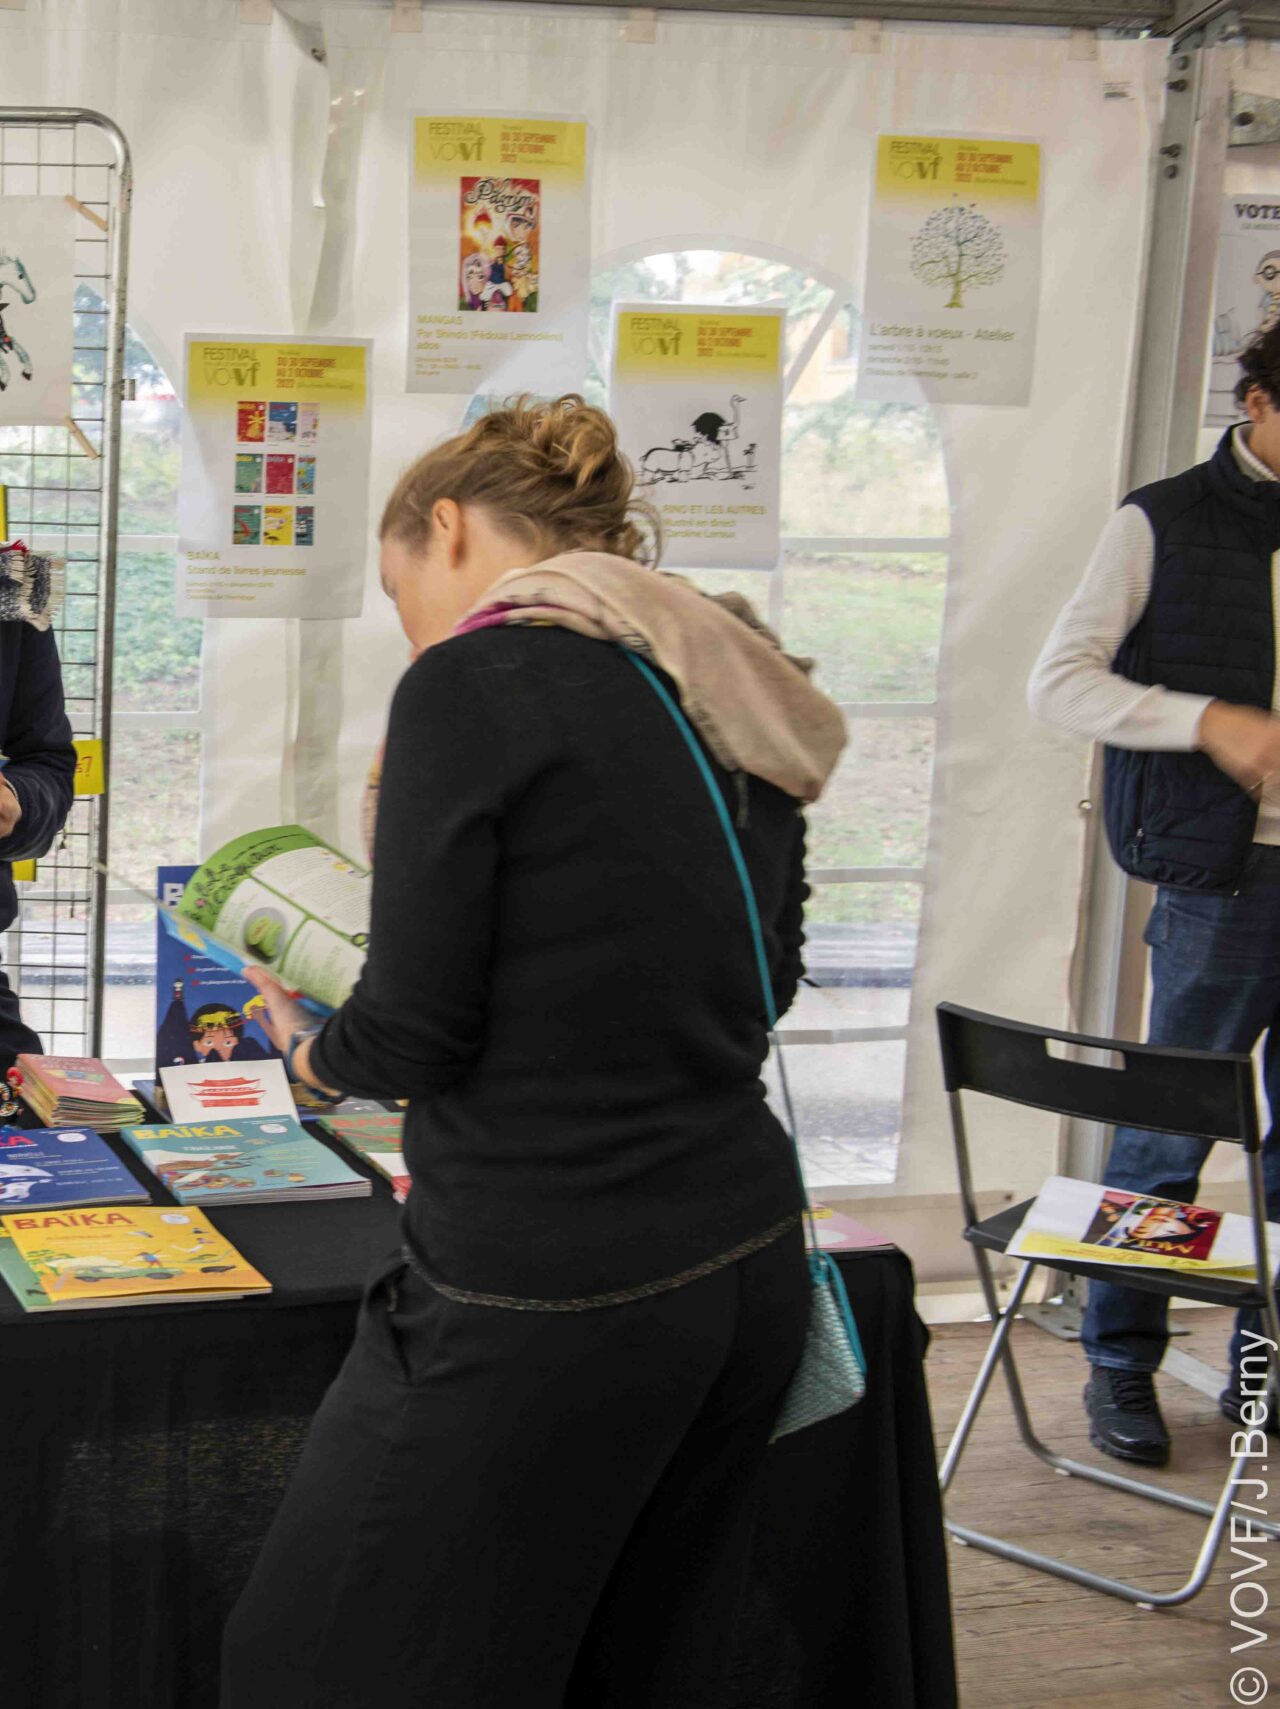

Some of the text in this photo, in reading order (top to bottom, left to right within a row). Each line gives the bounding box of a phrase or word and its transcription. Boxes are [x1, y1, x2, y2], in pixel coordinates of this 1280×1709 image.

[428, 121, 483, 135] FESTIVAL
[888, 140, 941, 154] FESTIVAL
[630, 318, 681, 331] FESTIVAL
[203, 347, 258, 362] FESTIVAL
[131, 1125, 242, 1140] BAÏKA
[14, 1213, 133, 1230] BAÏKA
